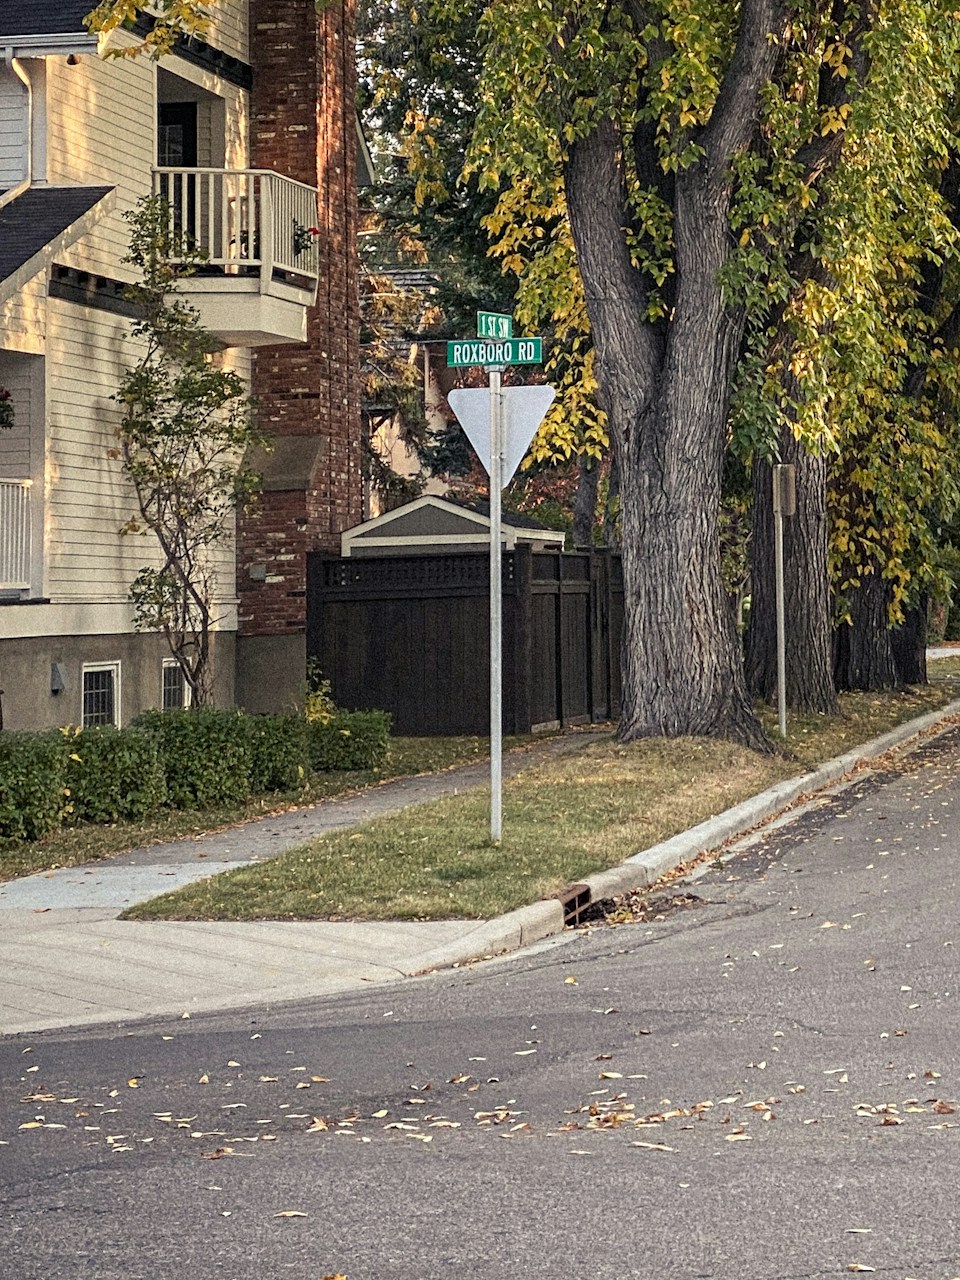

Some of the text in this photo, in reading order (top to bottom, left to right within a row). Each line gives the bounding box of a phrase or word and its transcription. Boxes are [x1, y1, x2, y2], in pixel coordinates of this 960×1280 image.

[481, 315, 509, 338] 1 ST SW
[453, 342, 535, 363] ROXBORO RD
